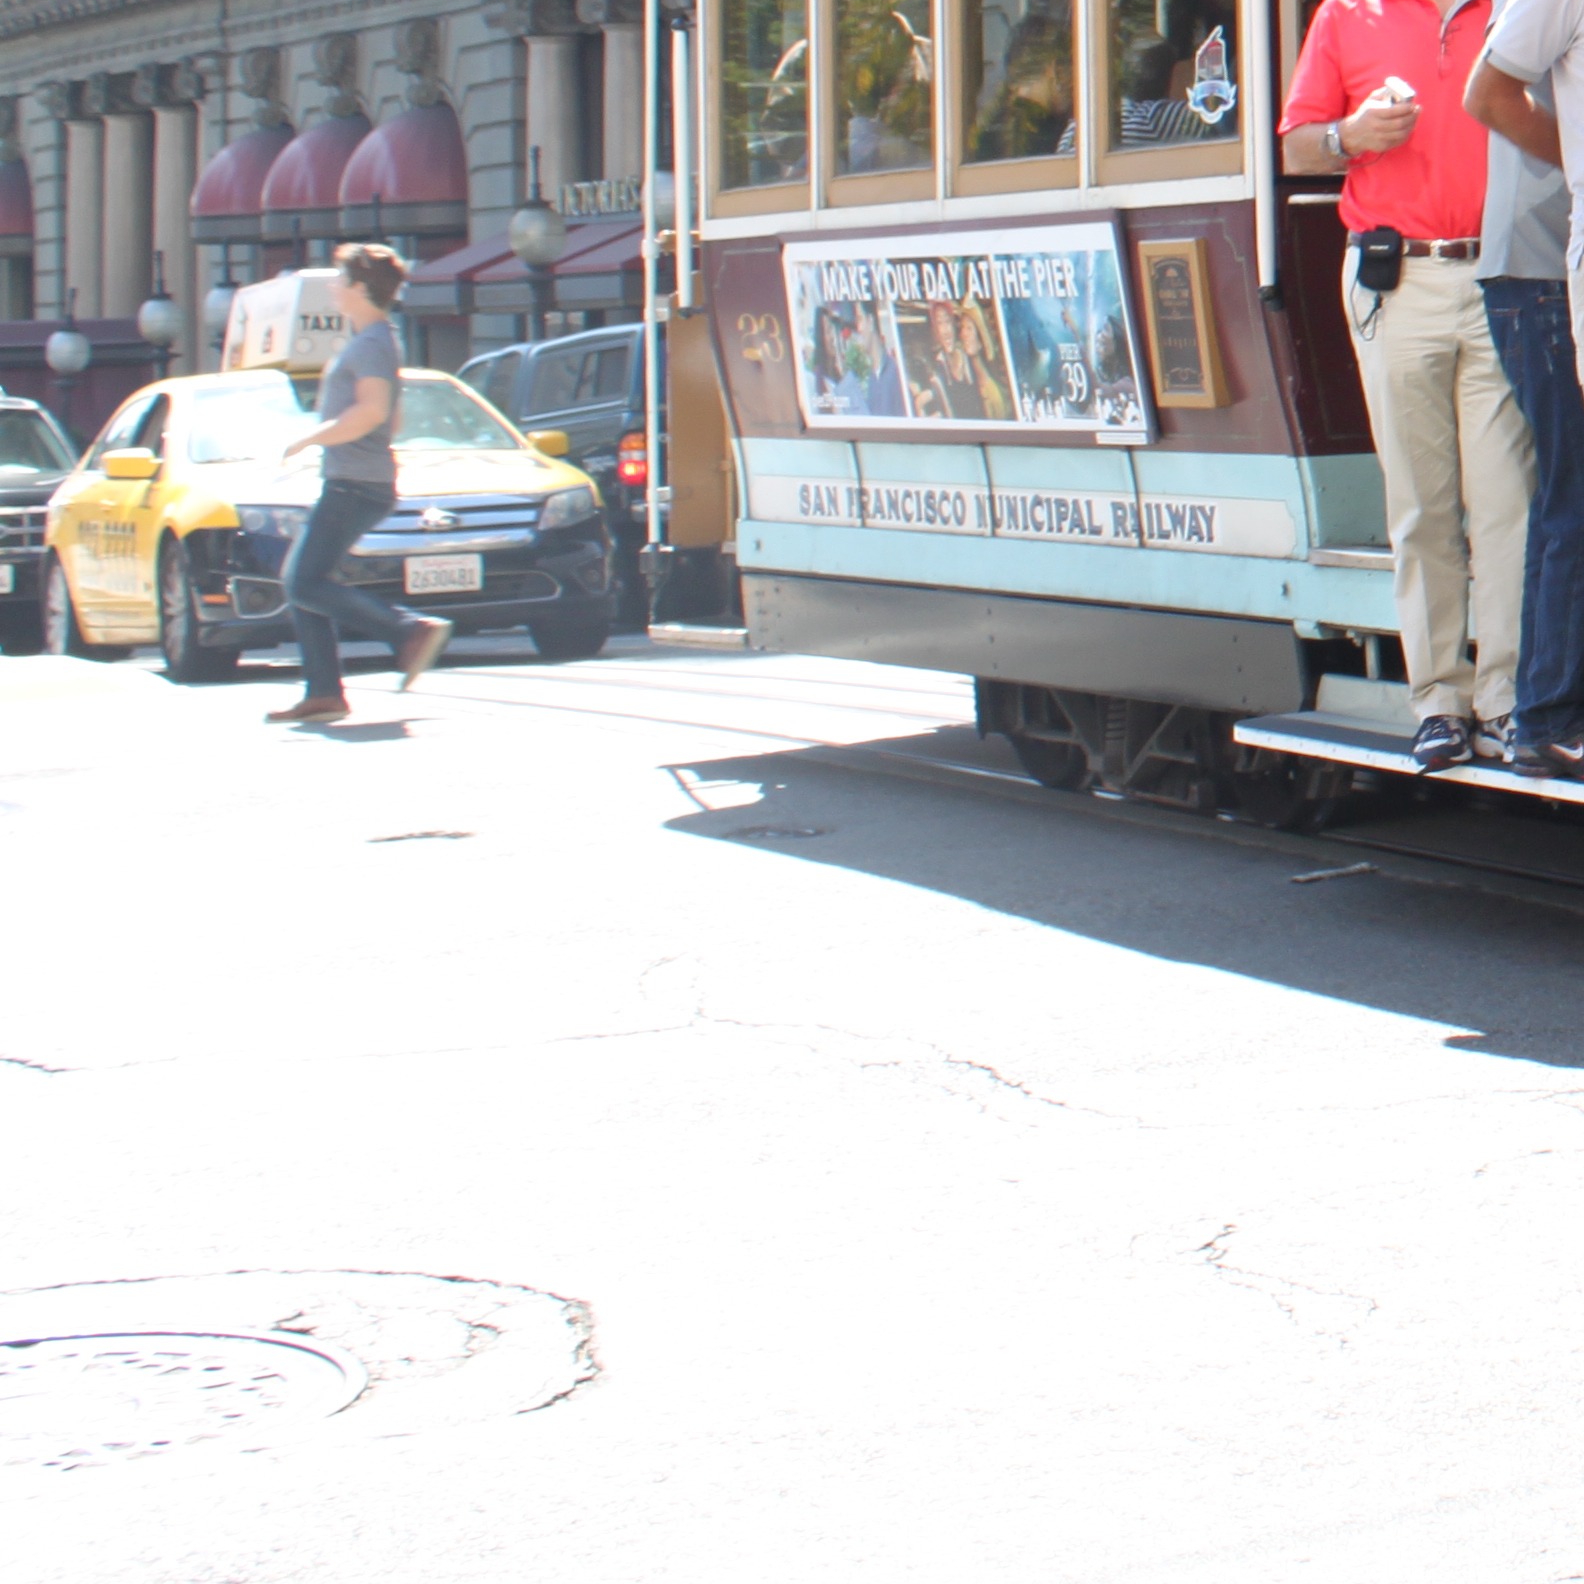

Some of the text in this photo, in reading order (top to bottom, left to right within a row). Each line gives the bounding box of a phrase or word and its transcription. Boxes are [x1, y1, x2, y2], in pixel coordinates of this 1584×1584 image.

[822, 257, 1079, 302] MAKE YOUR DAY AT THE PIER
[300, 313, 343, 331] TAXI
[736, 312, 784, 363] 23
[1061, 361, 1089, 404] 39
[799, 483, 1217, 545] SAN FRANCISCO MUNICIPAL RAILWAY
